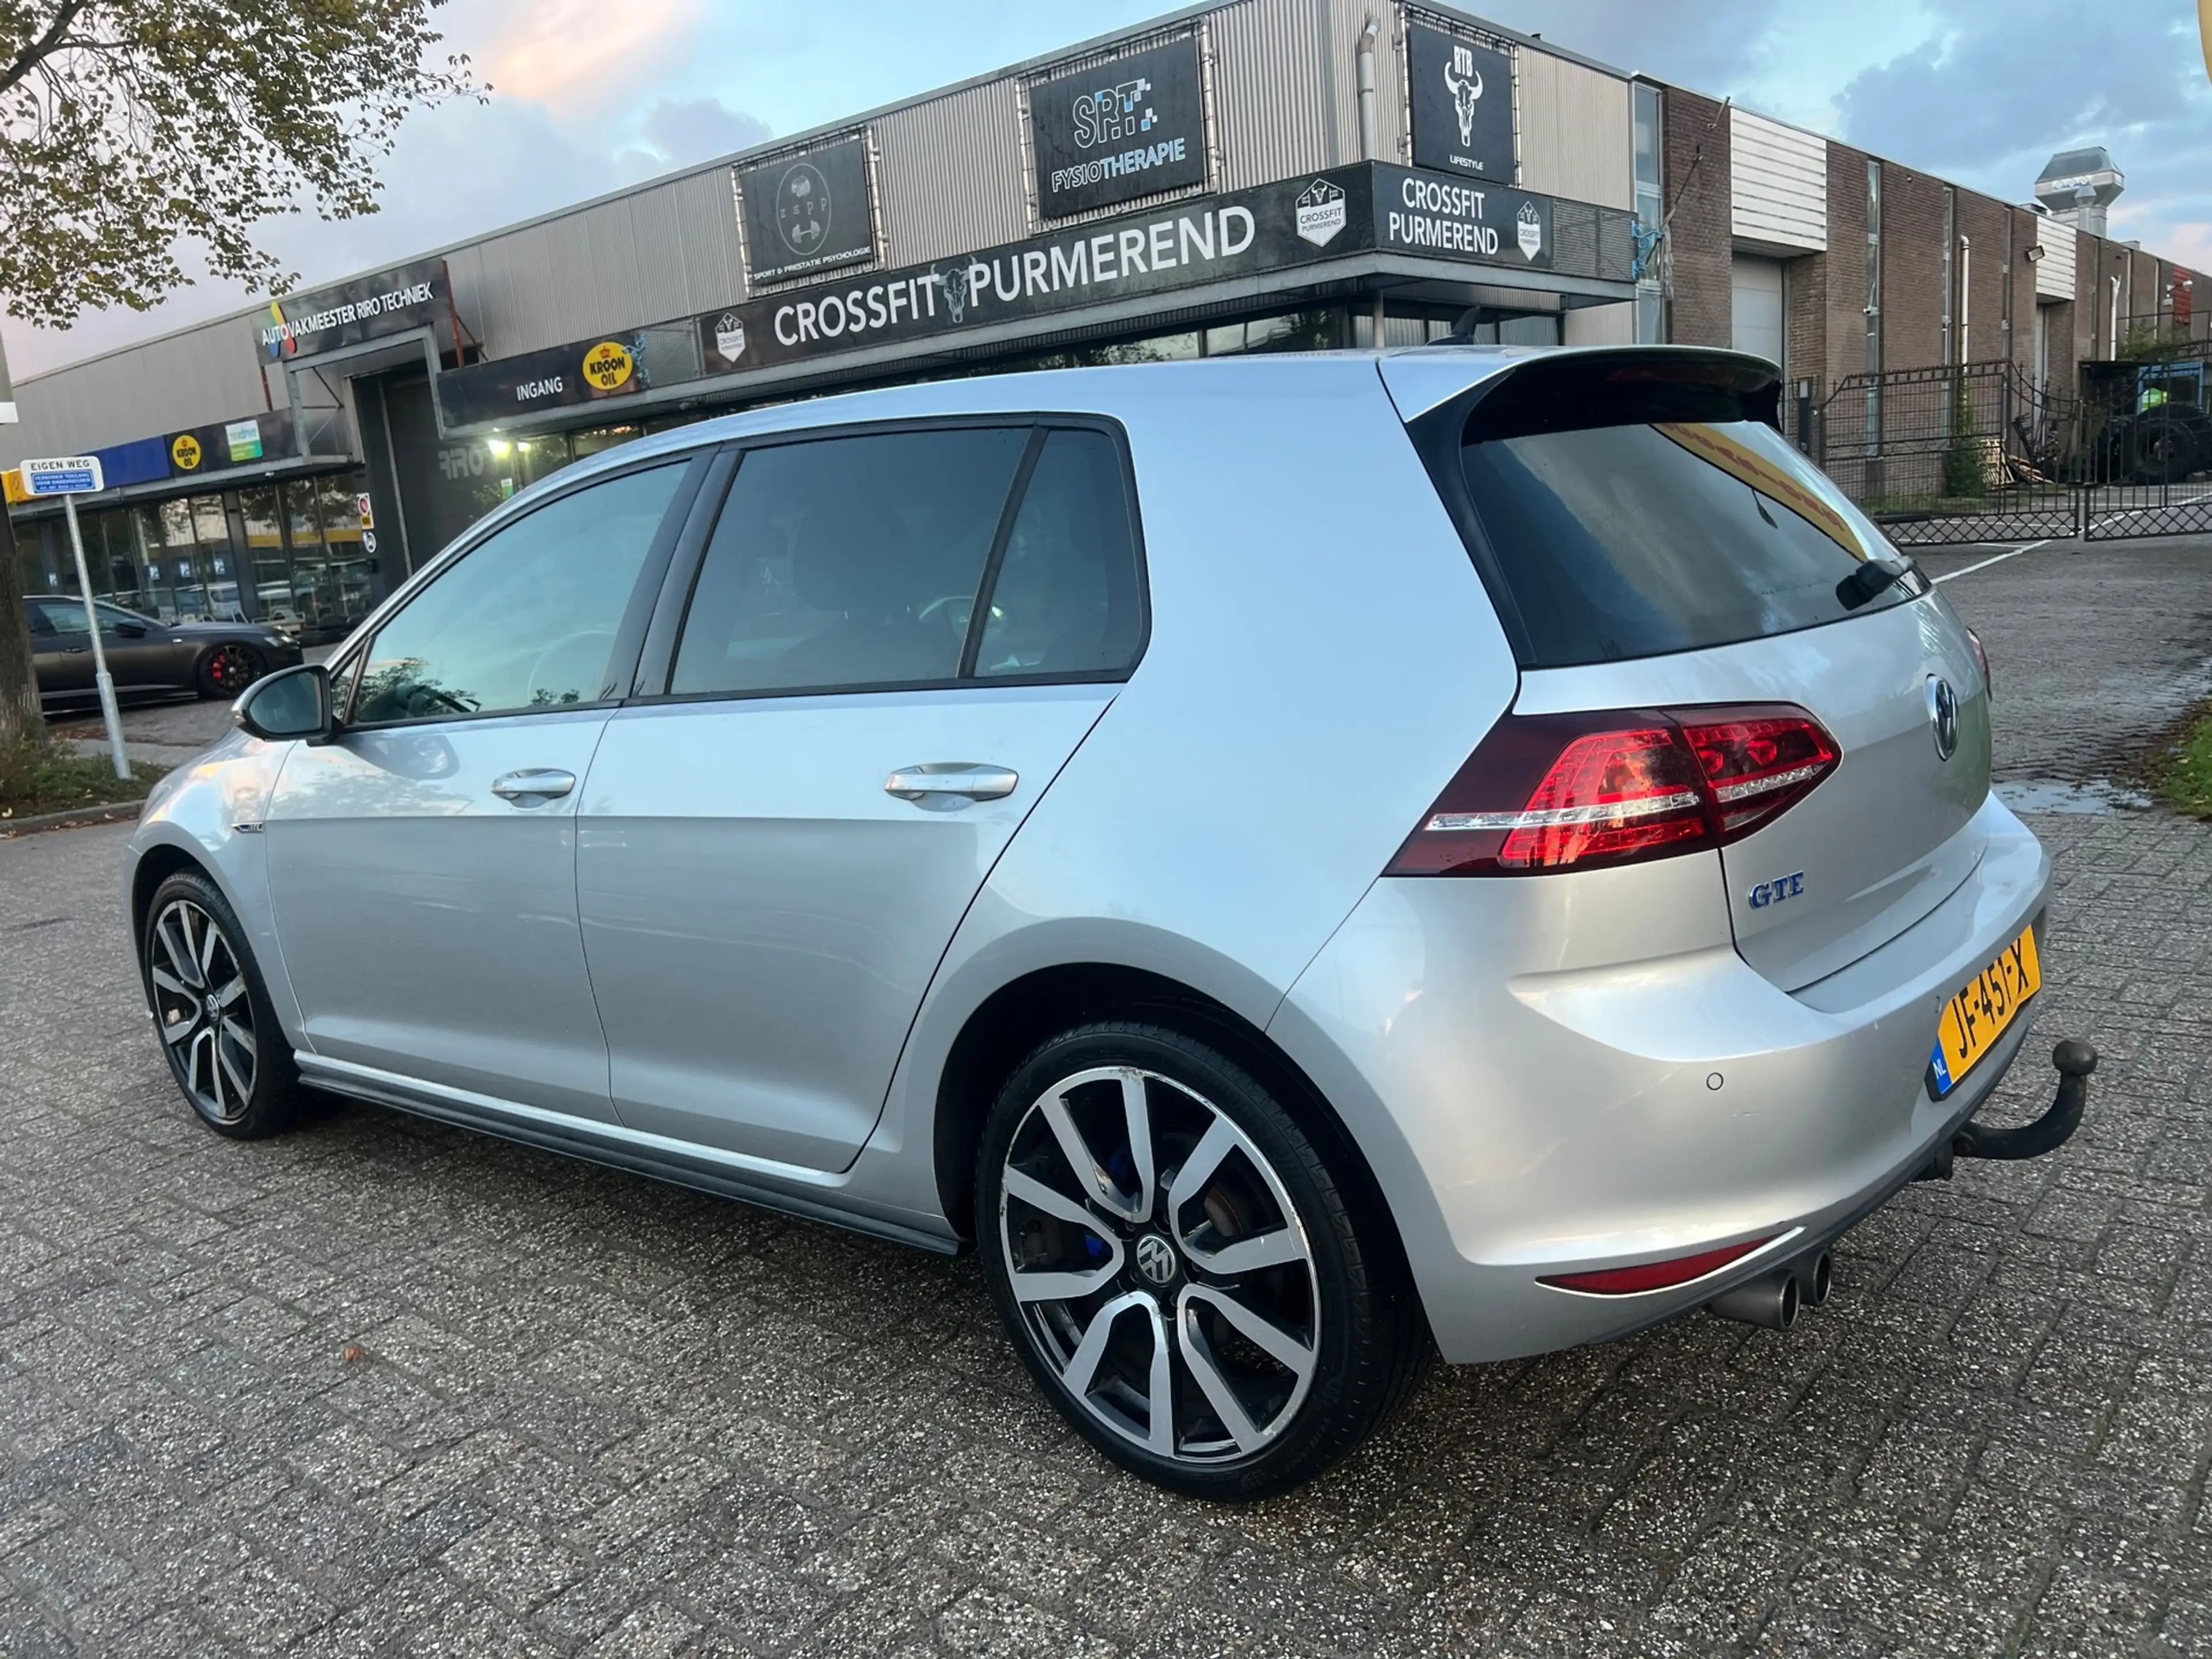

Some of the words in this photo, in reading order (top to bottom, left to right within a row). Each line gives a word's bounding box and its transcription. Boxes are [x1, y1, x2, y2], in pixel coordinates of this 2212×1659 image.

[1454, 45, 1473, 77] RTB
[1052, 138, 1186, 192] FYSIOTHERAPIE
[1449, 154, 1483, 171] LIFESTYLE
[1402, 177, 1485, 219] CROSSFIT
[1300, 207, 1342, 224] CROSSFIT
[1302, 218, 1342, 232] PURMEREND
[1389, 211, 1498, 255] PURMEREND
[753, 268, 776, 281] SPORT
[784, 259, 822, 272] PRESTATIE
[823, 246, 872, 264] PSYCHOLOGIE
[774, 274, 940, 346] CROSSFIT
[969, 205, 1255, 306] PURMEREND
[262, 305, 356, 346] AUTOVAKMEESTER
[356, 297, 381, 320] RIRO
[380, 282, 434, 312] TECHNIEK
[589, 356, 626, 376] KROON
[601, 373, 618, 387] OIL
[516, 376, 563, 402] INGANG
[31, 461, 63, 471] EIGEN
[67, 460, 90, 468] WEG
[176, 446, 197, 458] KROON
[1747, 870, 1804, 910] GTE
[1952, 937, 2029, 1059] JF-451-X
[1933, 1058, 1947, 1080] NL
